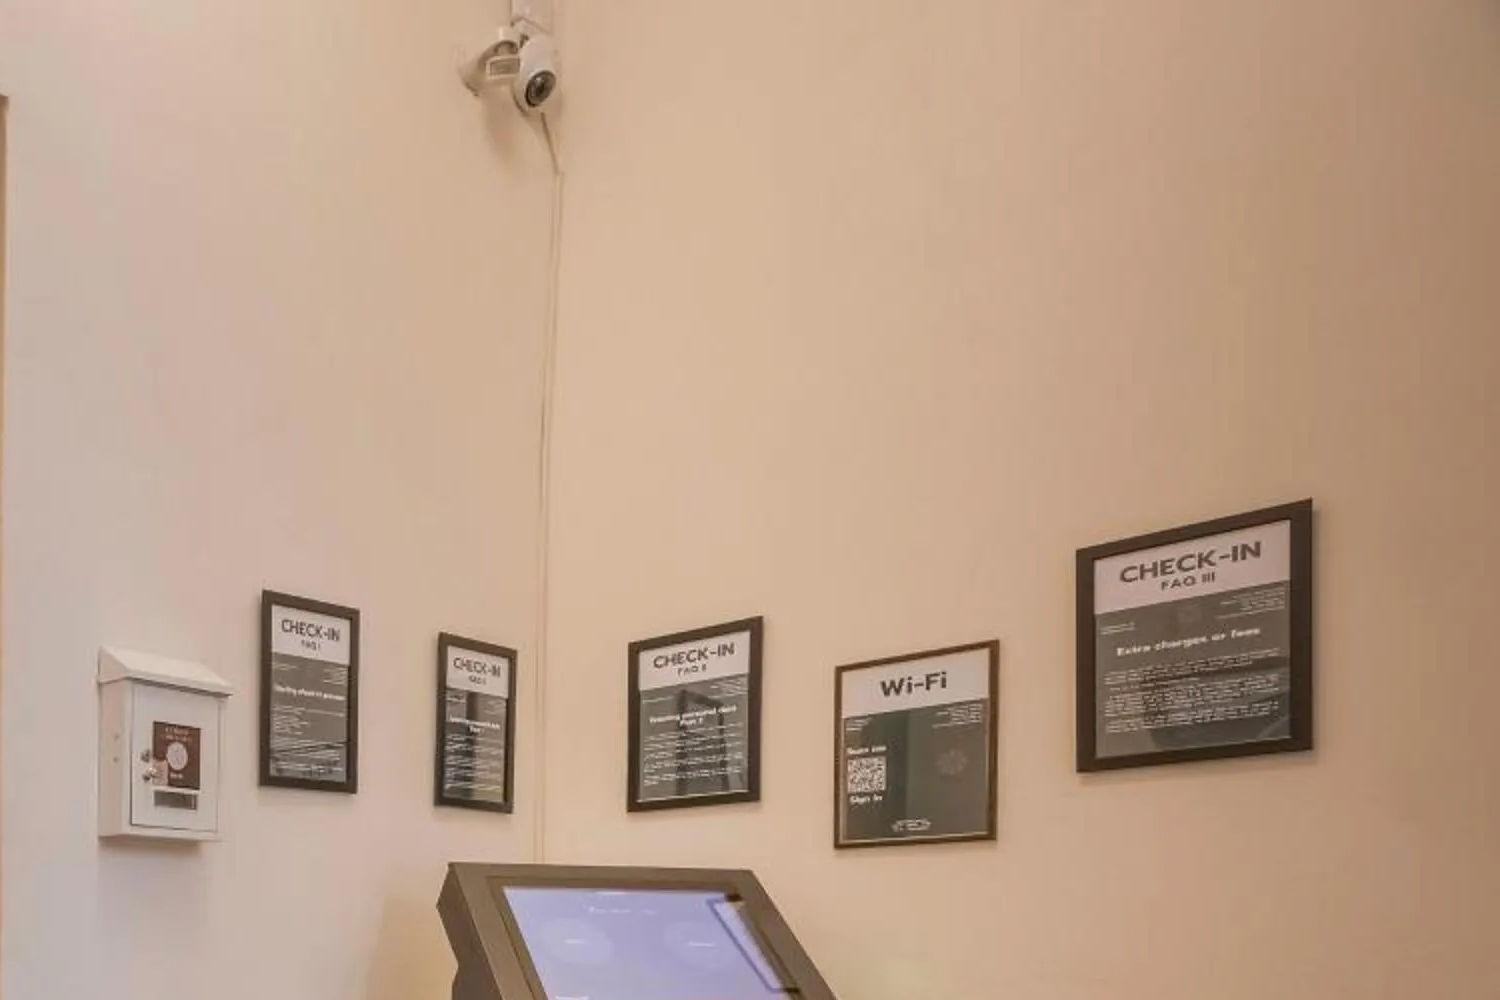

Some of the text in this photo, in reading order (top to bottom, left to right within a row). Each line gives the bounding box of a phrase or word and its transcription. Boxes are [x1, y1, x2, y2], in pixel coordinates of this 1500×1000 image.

[1120, 541, 1261, 583] CHECK-IN
[1161, 575, 1197, 590] FAQ
[281, 619, 341, 642] CHECK-IN
[653, 642, 735, 668] CHECK-IN
[453, 657, 501, 678] CHECK-IN
[881, 671, 947, 697] Wi-Fi
